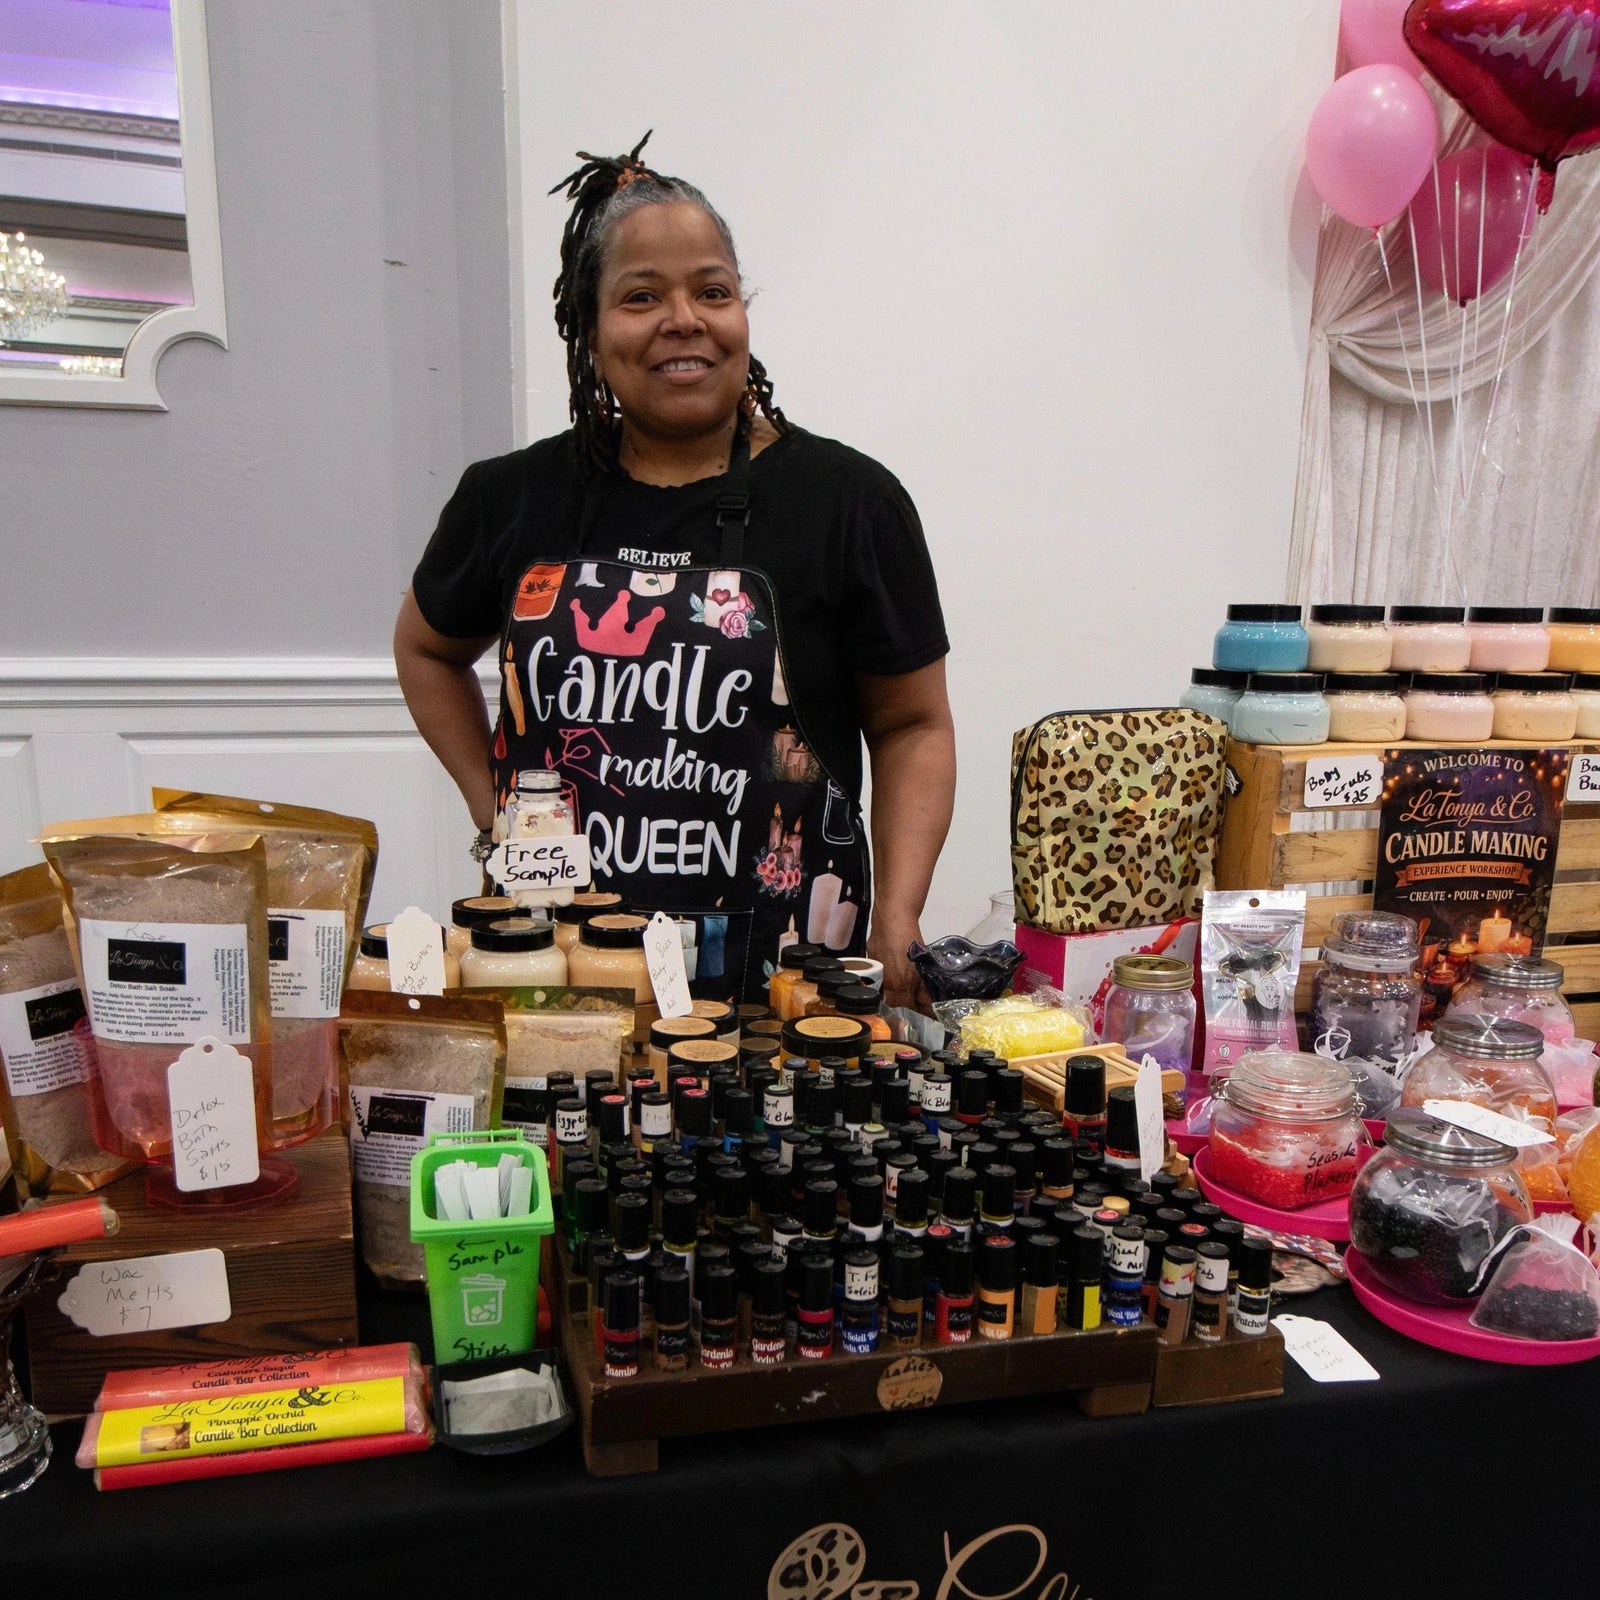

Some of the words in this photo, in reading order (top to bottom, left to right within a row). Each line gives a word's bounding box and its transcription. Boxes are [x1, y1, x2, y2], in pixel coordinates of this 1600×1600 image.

[617, 547, 691, 566] BELIEVE
[528, 635, 753, 733] Candle
[1424, 754, 1501, 773] WELCOME
[1504, 756, 1525, 773] TO
[599, 737, 751, 815] making
[1490, 795, 1508, 817] &
[1508, 790, 1537, 819] Co.
[504, 843, 568, 865] Free
[585, 810, 742, 878] QUEEN
[1385, 831, 1466, 864] CANDLE
[1470, 830, 1548, 861] MAKING
[504, 859, 578, 886] Sample
[1413, 864, 1467, 877] EXPERIENCE
[1469, 864, 1517, 875] WORKSHOP
[1409, 891, 1446, 902] CREATE
[1453, 890, 1479, 900] POUR
[1486, 890, 1515, 902] ENJOY
[448, 1241, 524, 1271] Sample
[100, 1267, 144, 1285] Wax
[192, 1379, 231, 1390] Candle
[233, 1376, 255, 1386] Bar
[259, 1370, 311, 1384] Collection
[206, 1366, 259, 1378] Cashmere
[262, 1364, 296, 1373] Sugar
[287, 1385, 333, 1410] &
[206, 1414, 263, 1427] Pineapple
[265, 1409, 305, 1421] Orchid
[194, 1431, 235, 1445] Candle
[237, 1427, 260, 1439] Bar
[263, 1420, 318, 1437] Collection
